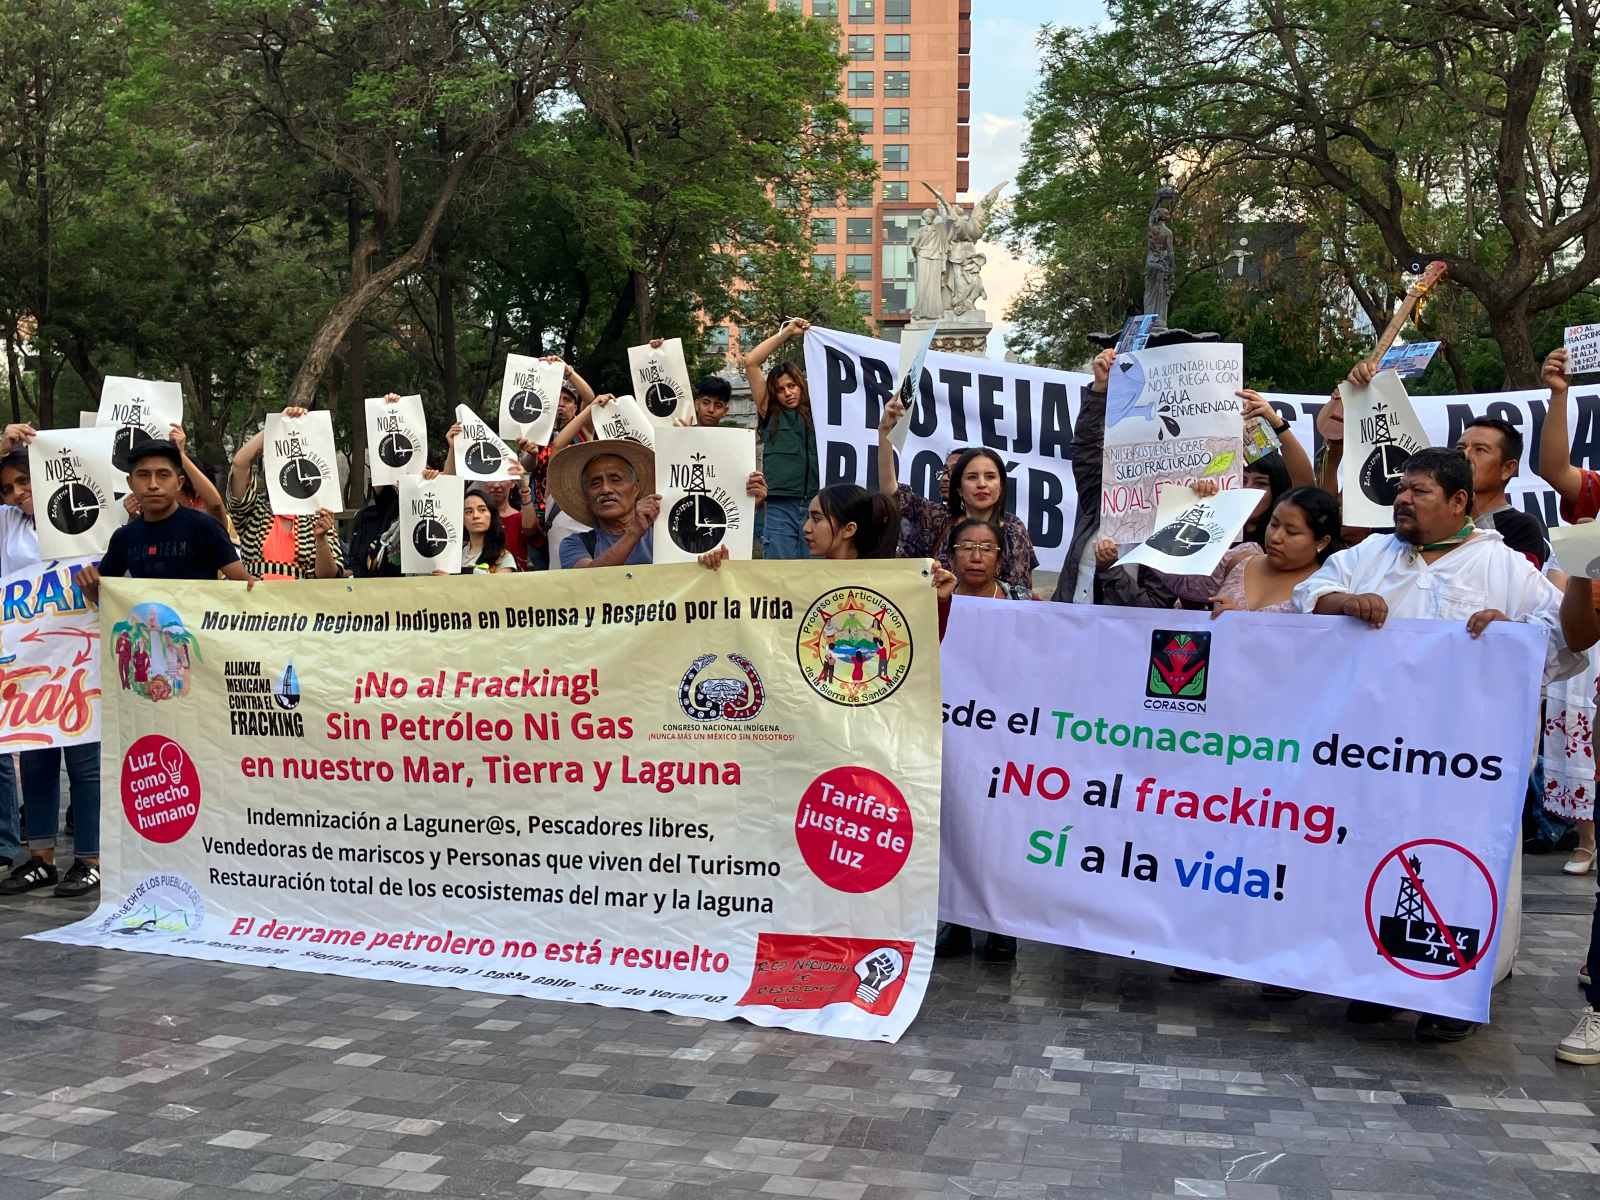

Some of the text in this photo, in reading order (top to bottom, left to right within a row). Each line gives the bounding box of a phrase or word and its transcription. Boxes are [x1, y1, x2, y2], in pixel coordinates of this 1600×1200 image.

[513, 372, 526, 386] NO
[640, 367, 650, 383] NO
[1148, 379, 1162, 392] NO
[1179, 373, 1210, 386] RIEGA
[1216, 372, 1239, 384] CON
[1149, 367, 1160, 379] LA
[824, 345, 1092, 460] PROTEJA
[1159, 389, 1190, 405] AGUA
[111, 404, 129, 422] NO
[377, 416, 388, 432] NO
[463, 424, 476, 440] NO
[602, 422, 616, 438] NO
[1360, 411, 1400, 444] NO AL
[274, 440, 290, 457] NO
[45, 460, 62, 481] NO
[669, 464, 716, 488] NO AL
[1145, 452, 1212, 474] FRACTURADO
[412, 499, 424, 516] NO
[712, 486, 741, 530] FRACKING
[1103, 486, 1128, 513] NO
[1130, 487, 1151, 510] AL
[201, 596, 792, 633] Movimiento Regional Indígena en Defensa y Respeto por la Vida
[803, 590, 903, 634] Proceso de Articulación
[225, 662, 260, 676] ALIANZA
[226, 679, 271, 693] MEXICANA
[354, 669, 599, 705] ¡No al Fracking!
[804, 664, 906, 703] de la Sierra de Santa Marta
[228, 694, 274, 710] CONTRA EL
[1144, 699, 1206, 712] CORASON
[231, 711, 304, 737] FRACKING
[327, 712, 633, 741] Sin Petróleo Ni Gas
[648, 732, 675, 740] ¡NUNCA
[676, 732, 692, 740] MÁS
[707, 732, 736, 740] MÉXICO
[752, 733, 795, 742] NOSOTROS!
[744, 723, 780, 732] INDÍGENA
[1008, 707, 1039, 736] el
[1052, 711, 1299, 765] Totonacapan
[1313, 734, 1502, 781] decimos
[128, 752, 157, 772] Luz
[241, 756, 740, 793] en nuestro Mar, Tierra y Laguna
[130, 772, 166, 793] como
[134, 784, 190, 811] derecho
[820, 782, 900, 823] Tarifas
[988, 762, 1347, 844] ¡NO al fracking,
[138, 802, 196, 830] humano
[248, 808, 714, 841] Indemnización a Laguner@s, Pescadores libres,
[798, 804, 906, 853] justas de
[202, 837, 780, 876] Vendedoras de mariscos y Personas que viven del Turismo
[829, 840, 865, 869] luz
[1027, 826, 1286, 901] SÍ a la vida!
[136, 884, 147, 897] DE
[146, 876, 161, 891] LOS
[161, 875, 192, 897] PUEBLOS
[210, 868, 773, 917] Restauración total de los ecosistemas del mar y la laguna
[230, 917, 255, 935] El
[257, 919, 366, 945] derrame
[366, 930, 495, 956] petrolero
[502, 941, 537, 958] no
[545, 939, 601, 964] está
[610, 945, 729, 972] resuelto
[481, 970, 531, 981] Costa
[531, 976, 577, 988] Golfo
[650, 989, 729, 1004] Veracruz
